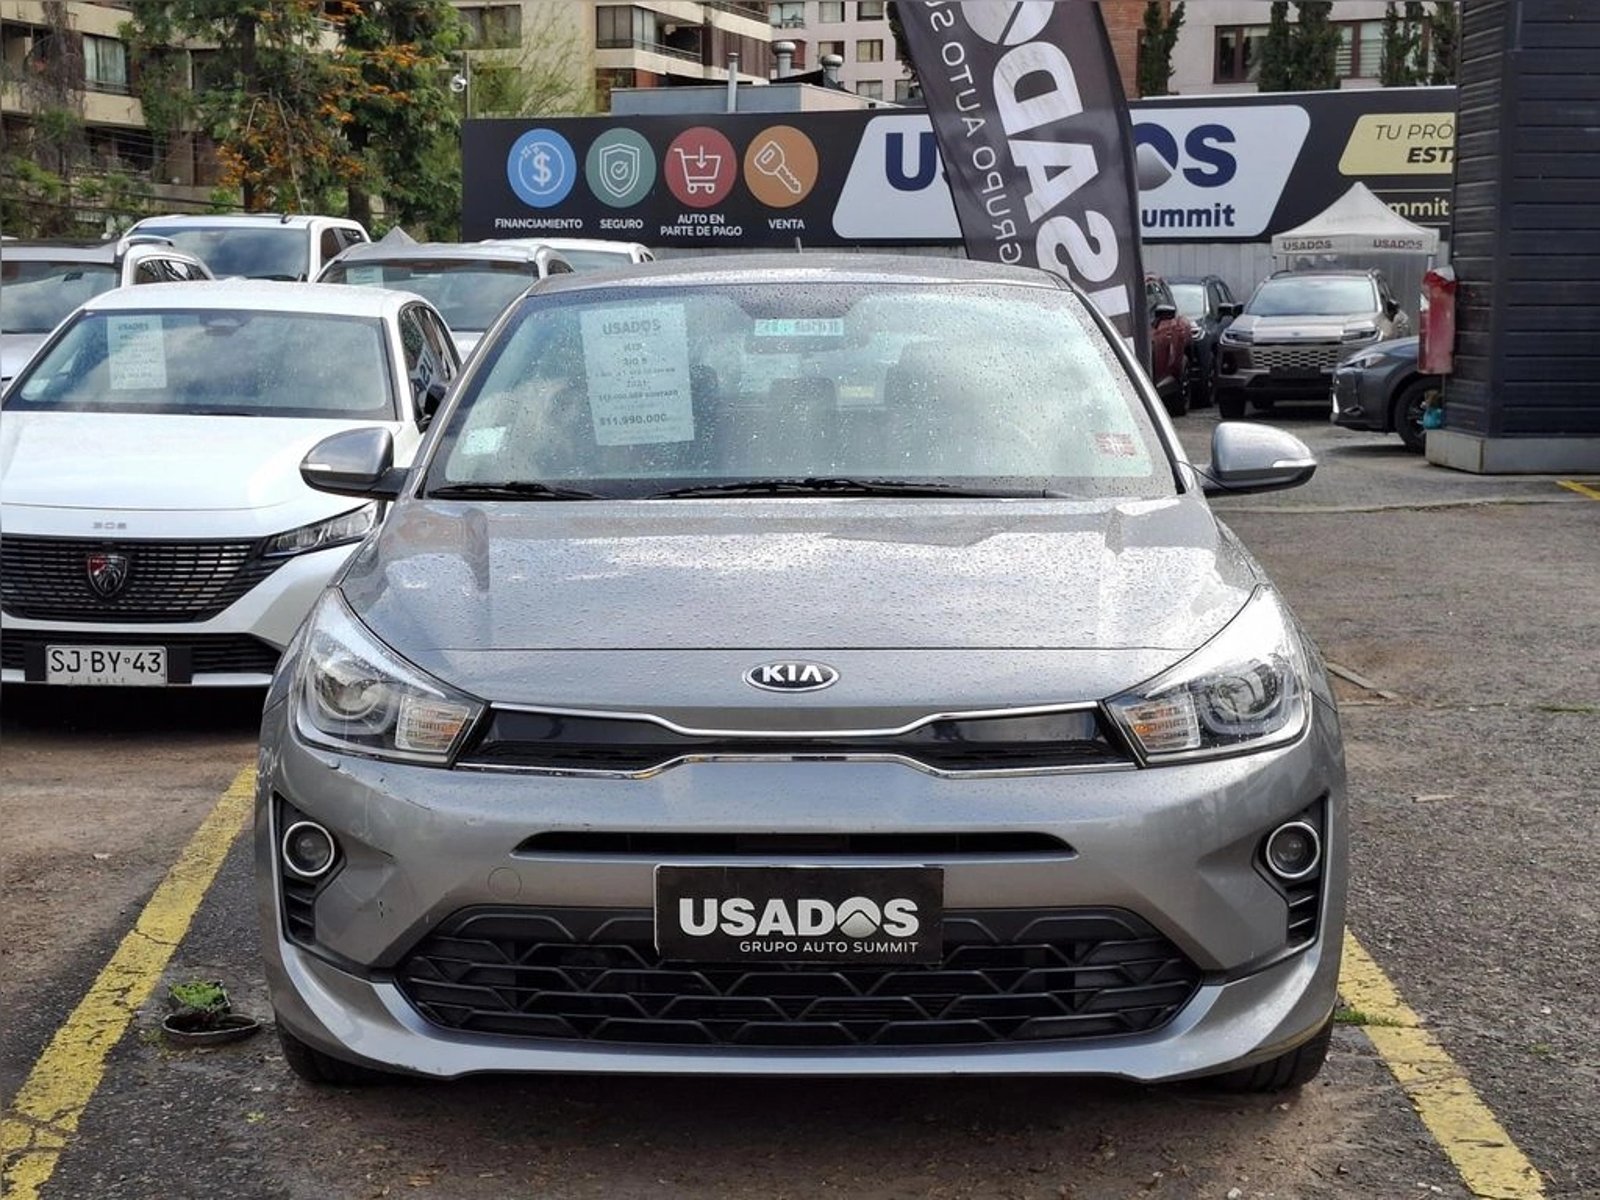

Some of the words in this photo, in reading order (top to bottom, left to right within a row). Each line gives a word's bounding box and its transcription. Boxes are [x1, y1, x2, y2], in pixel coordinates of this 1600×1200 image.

[1375, 124, 1402, 140] TU
[1407, 119, 1454, 140] PRÓ
[1407, 146, 1456, 163] EST
[1387, 197, 1450, 216] mmit
[677, 213, 709, 224] AUTO
[710, 213, 725, 224] EN
[1141, 203, 1235, 227] ummit
[494, 218, 584, 229] FINANCIAMIENTO
[600, 218, 644, 229] SEGURO
[768, 218, 806, 229] VENTA
[660, 226, 695, 236] PARTE
[696, 226, 711, 236] DE
[713, 225, 743, 236] PAGO
[1283, 239, 1333, 250] USADOS
[1373, 238, 1423, 249] USADOS
[762, 664, 823, 682] KIA
[678, 895, 920, 938] USADOS
[739, 941, 798, 953] GRUPO
[803, 941, 848, 953] AUTO
[853, 941, 919, 953] SUMMIT
